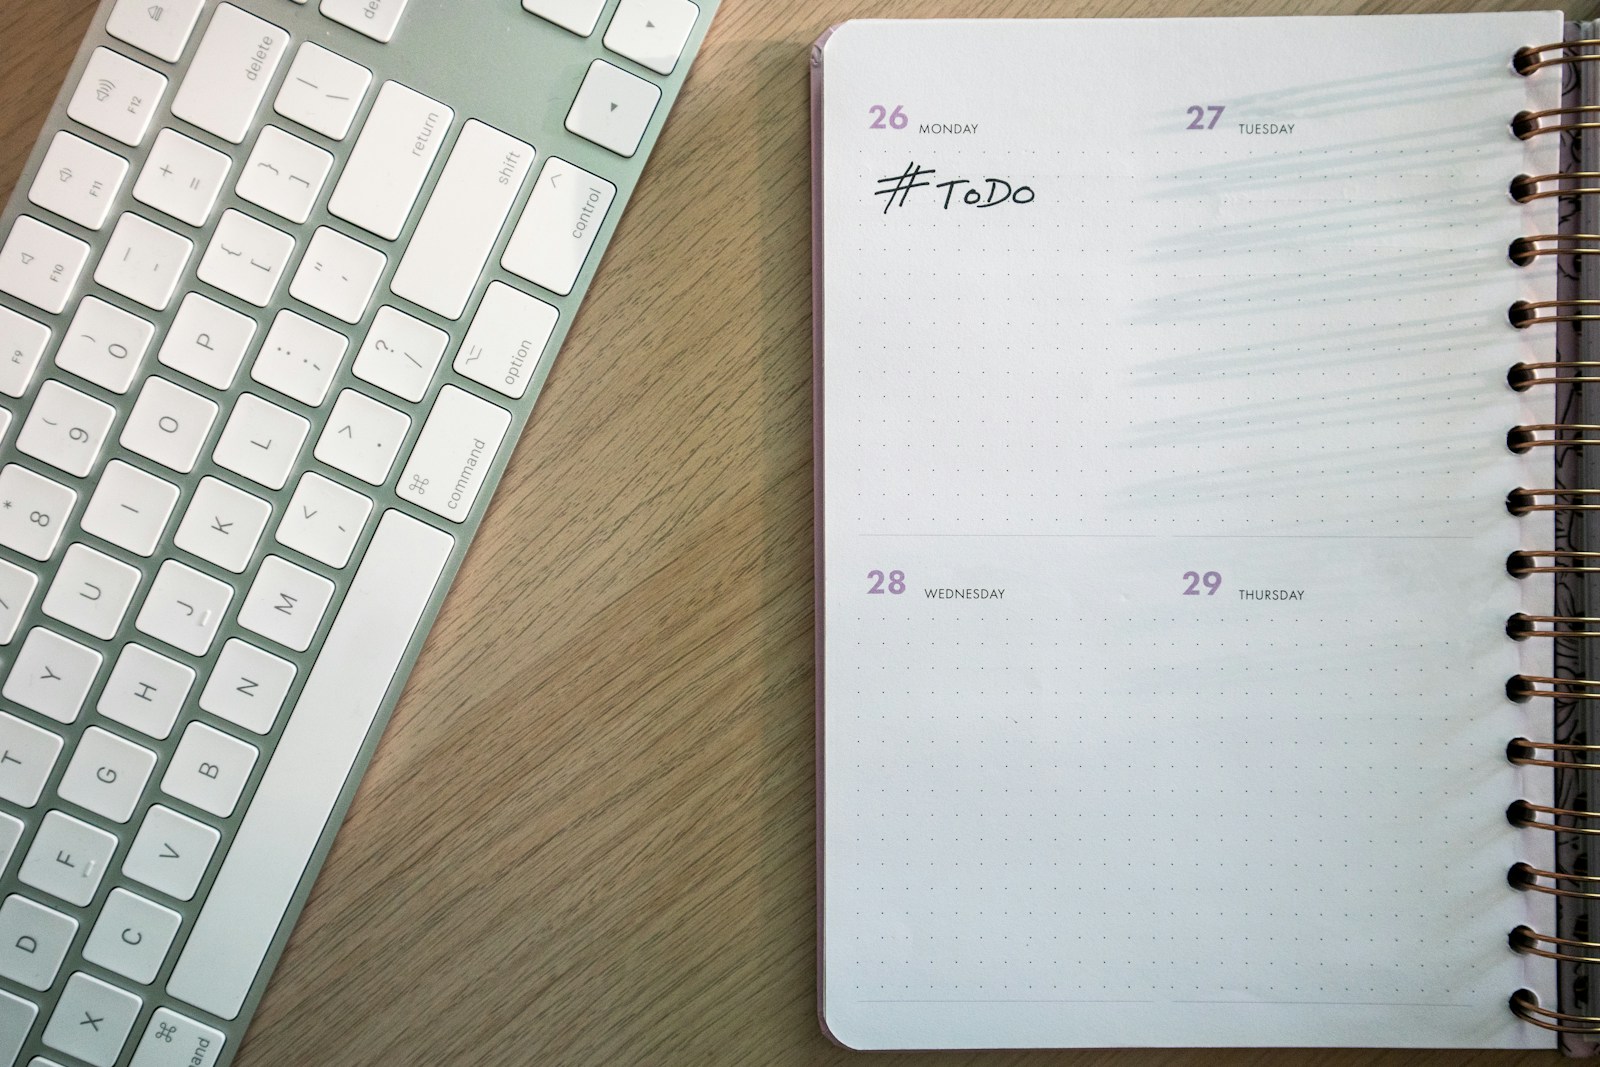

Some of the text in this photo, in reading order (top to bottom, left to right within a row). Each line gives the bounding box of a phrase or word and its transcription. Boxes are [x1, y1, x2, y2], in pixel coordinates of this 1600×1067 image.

[363, 0, 381, 19] de
[246, 36, 273, 81] delete
[127, 95, 142, 115] F12
[868, 104, 979, 135] 26 MONDAY
[1185, 105, 1295, 135] 27 TUESDAY
[412, 111, 439, 157] return
[499, 151, 521, 186] shift
[88, 180, 103, 198] F11
[572, 188, 602, 239] control
[49, 263, 65, 283] F10
[108, 343, 128, 360] 0
[195, 333, 214, 351] P
[11, 349, 24, 365] F9
[504, 339, 532, 385] option
[158, 415, 179, 434] O
[68, 427, 89, 444] 9
[250, 439, 272, 450] L
[448, 438, 486, 510] command
[29, 510, 50, 528] 8
[210, 516, 234, 535] K
[79, 582, 102, 601] U
[866, 569, 1006, 600] 28 WEDNESDAY
[1182, 570, 1305, 601] 29 THURSDAY
[176, 600, 194, 617] J
[273, 592, 298, 616] M
[40, 665, 61, 681] Y
[133, 681, 157, 702] H
[236, 677, 259, 697] N
[0, 749, 22, 765] T
[96, 766, 118, 784] G
[198, 762, 220, 780] B
[55, 850, 75, 869] F
[158, 842, 180, 859] V
[15, 935, 38, 954] D
[121, 928, 143, 946] C
[79, 1011, 104, 1032] X
[188, 1036, 210, 1067] and
